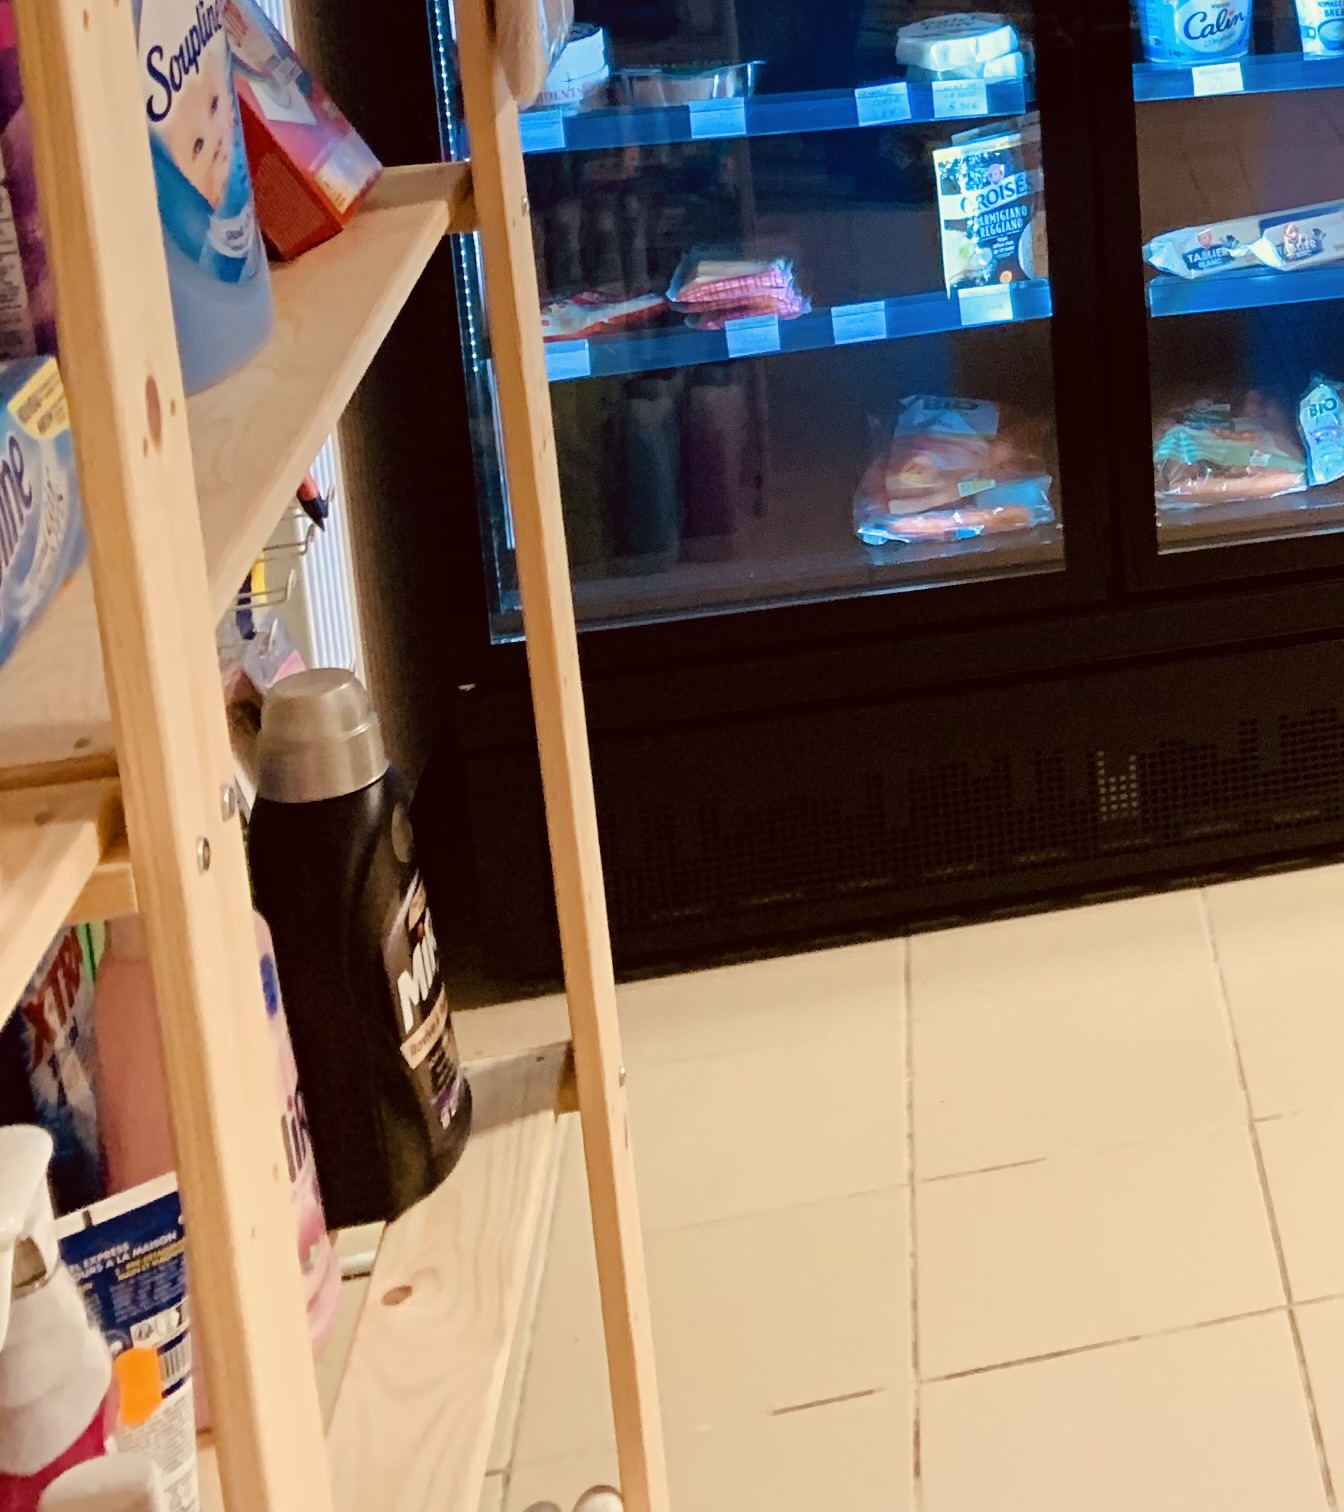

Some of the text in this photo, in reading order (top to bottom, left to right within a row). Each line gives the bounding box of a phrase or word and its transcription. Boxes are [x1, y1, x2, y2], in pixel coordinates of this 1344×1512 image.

[1183, 8, 1247, 41] Calin
[1308, 397, 1338, 417] BIO
[132, 1230, 177, 1258] MAISON
